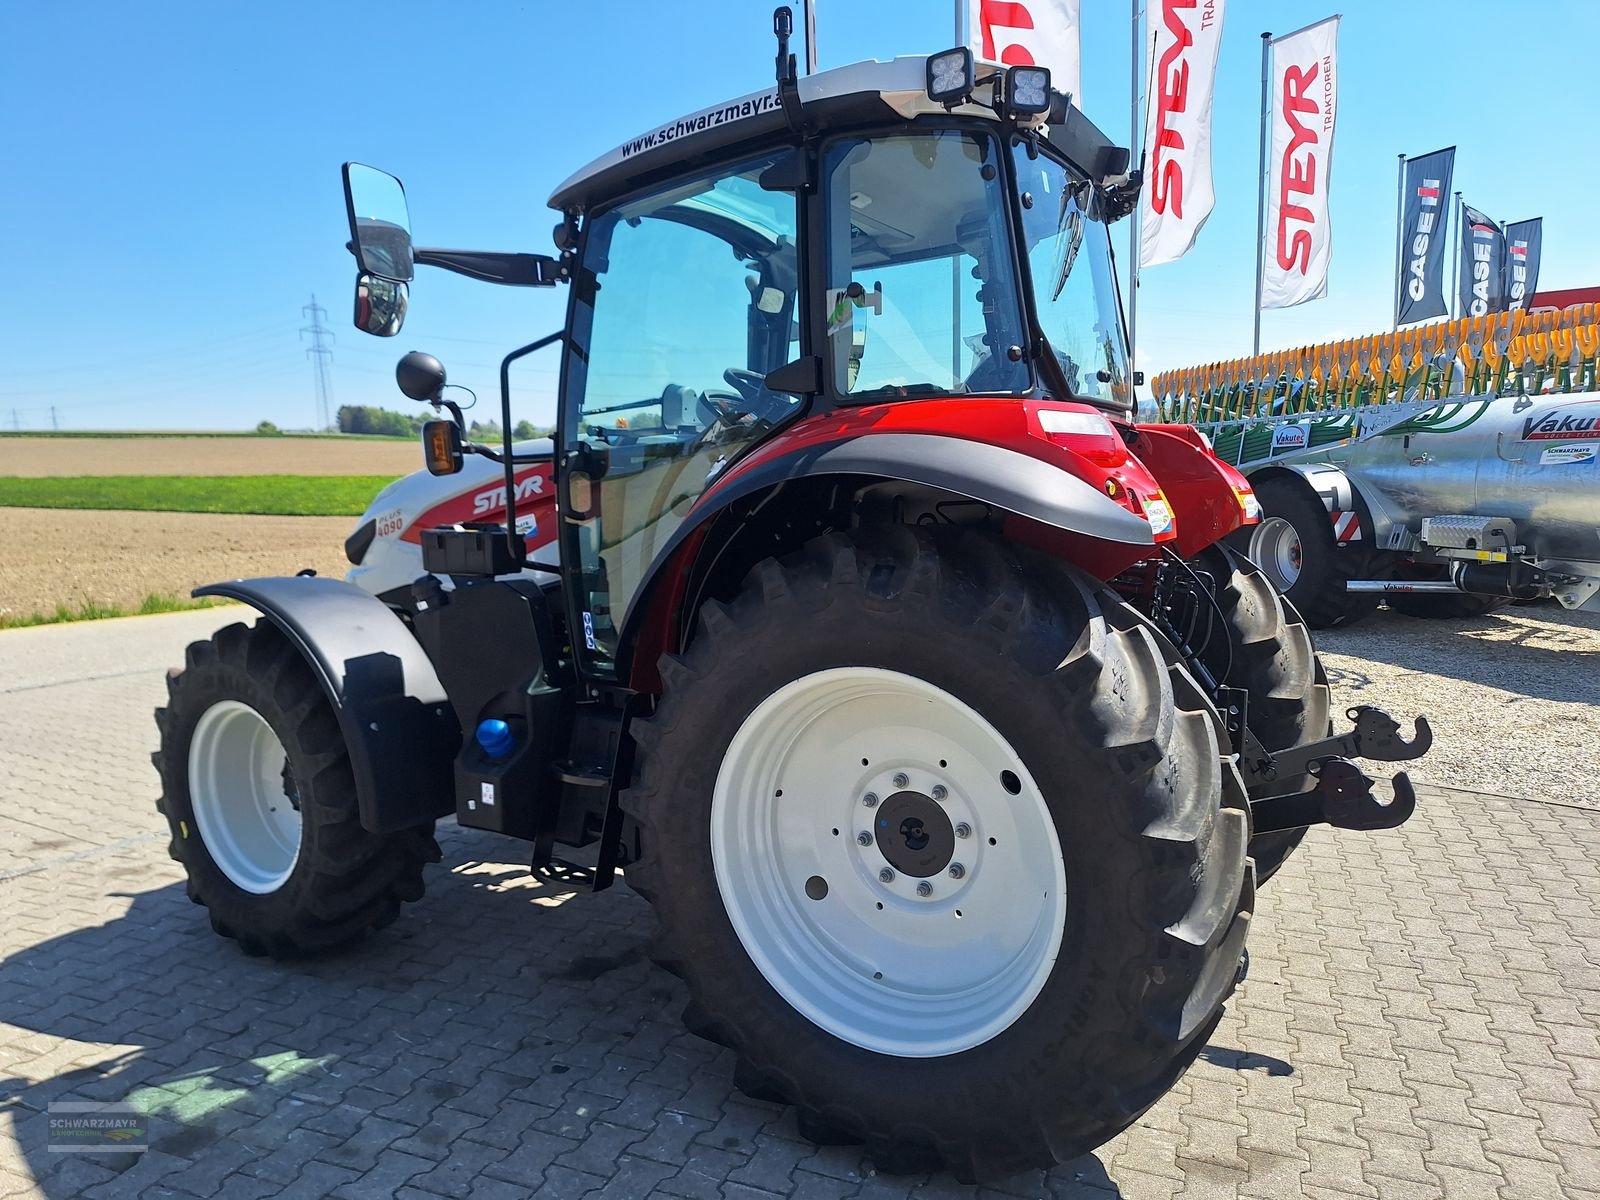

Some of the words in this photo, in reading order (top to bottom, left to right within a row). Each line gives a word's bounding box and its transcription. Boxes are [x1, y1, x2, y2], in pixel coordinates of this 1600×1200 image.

[622, 93, 783, 157] www.schwarzmayr.a
[1150, 0, 1197, 219] STEY
[1323, 55, 1332, 132] TRAKTOREN
[1276, 62, 1319, 276] STEYR
[1409, 212, 1435, 302] CASE
[1470, 242, 1492, 317] CASE
[1508, 265, 1527, 312] ASE
[1276, 432, 1305, 445] Vakutec
[1522, 411, 1600, 440] Vaku
[473, 475, 544, 515] STEYR
